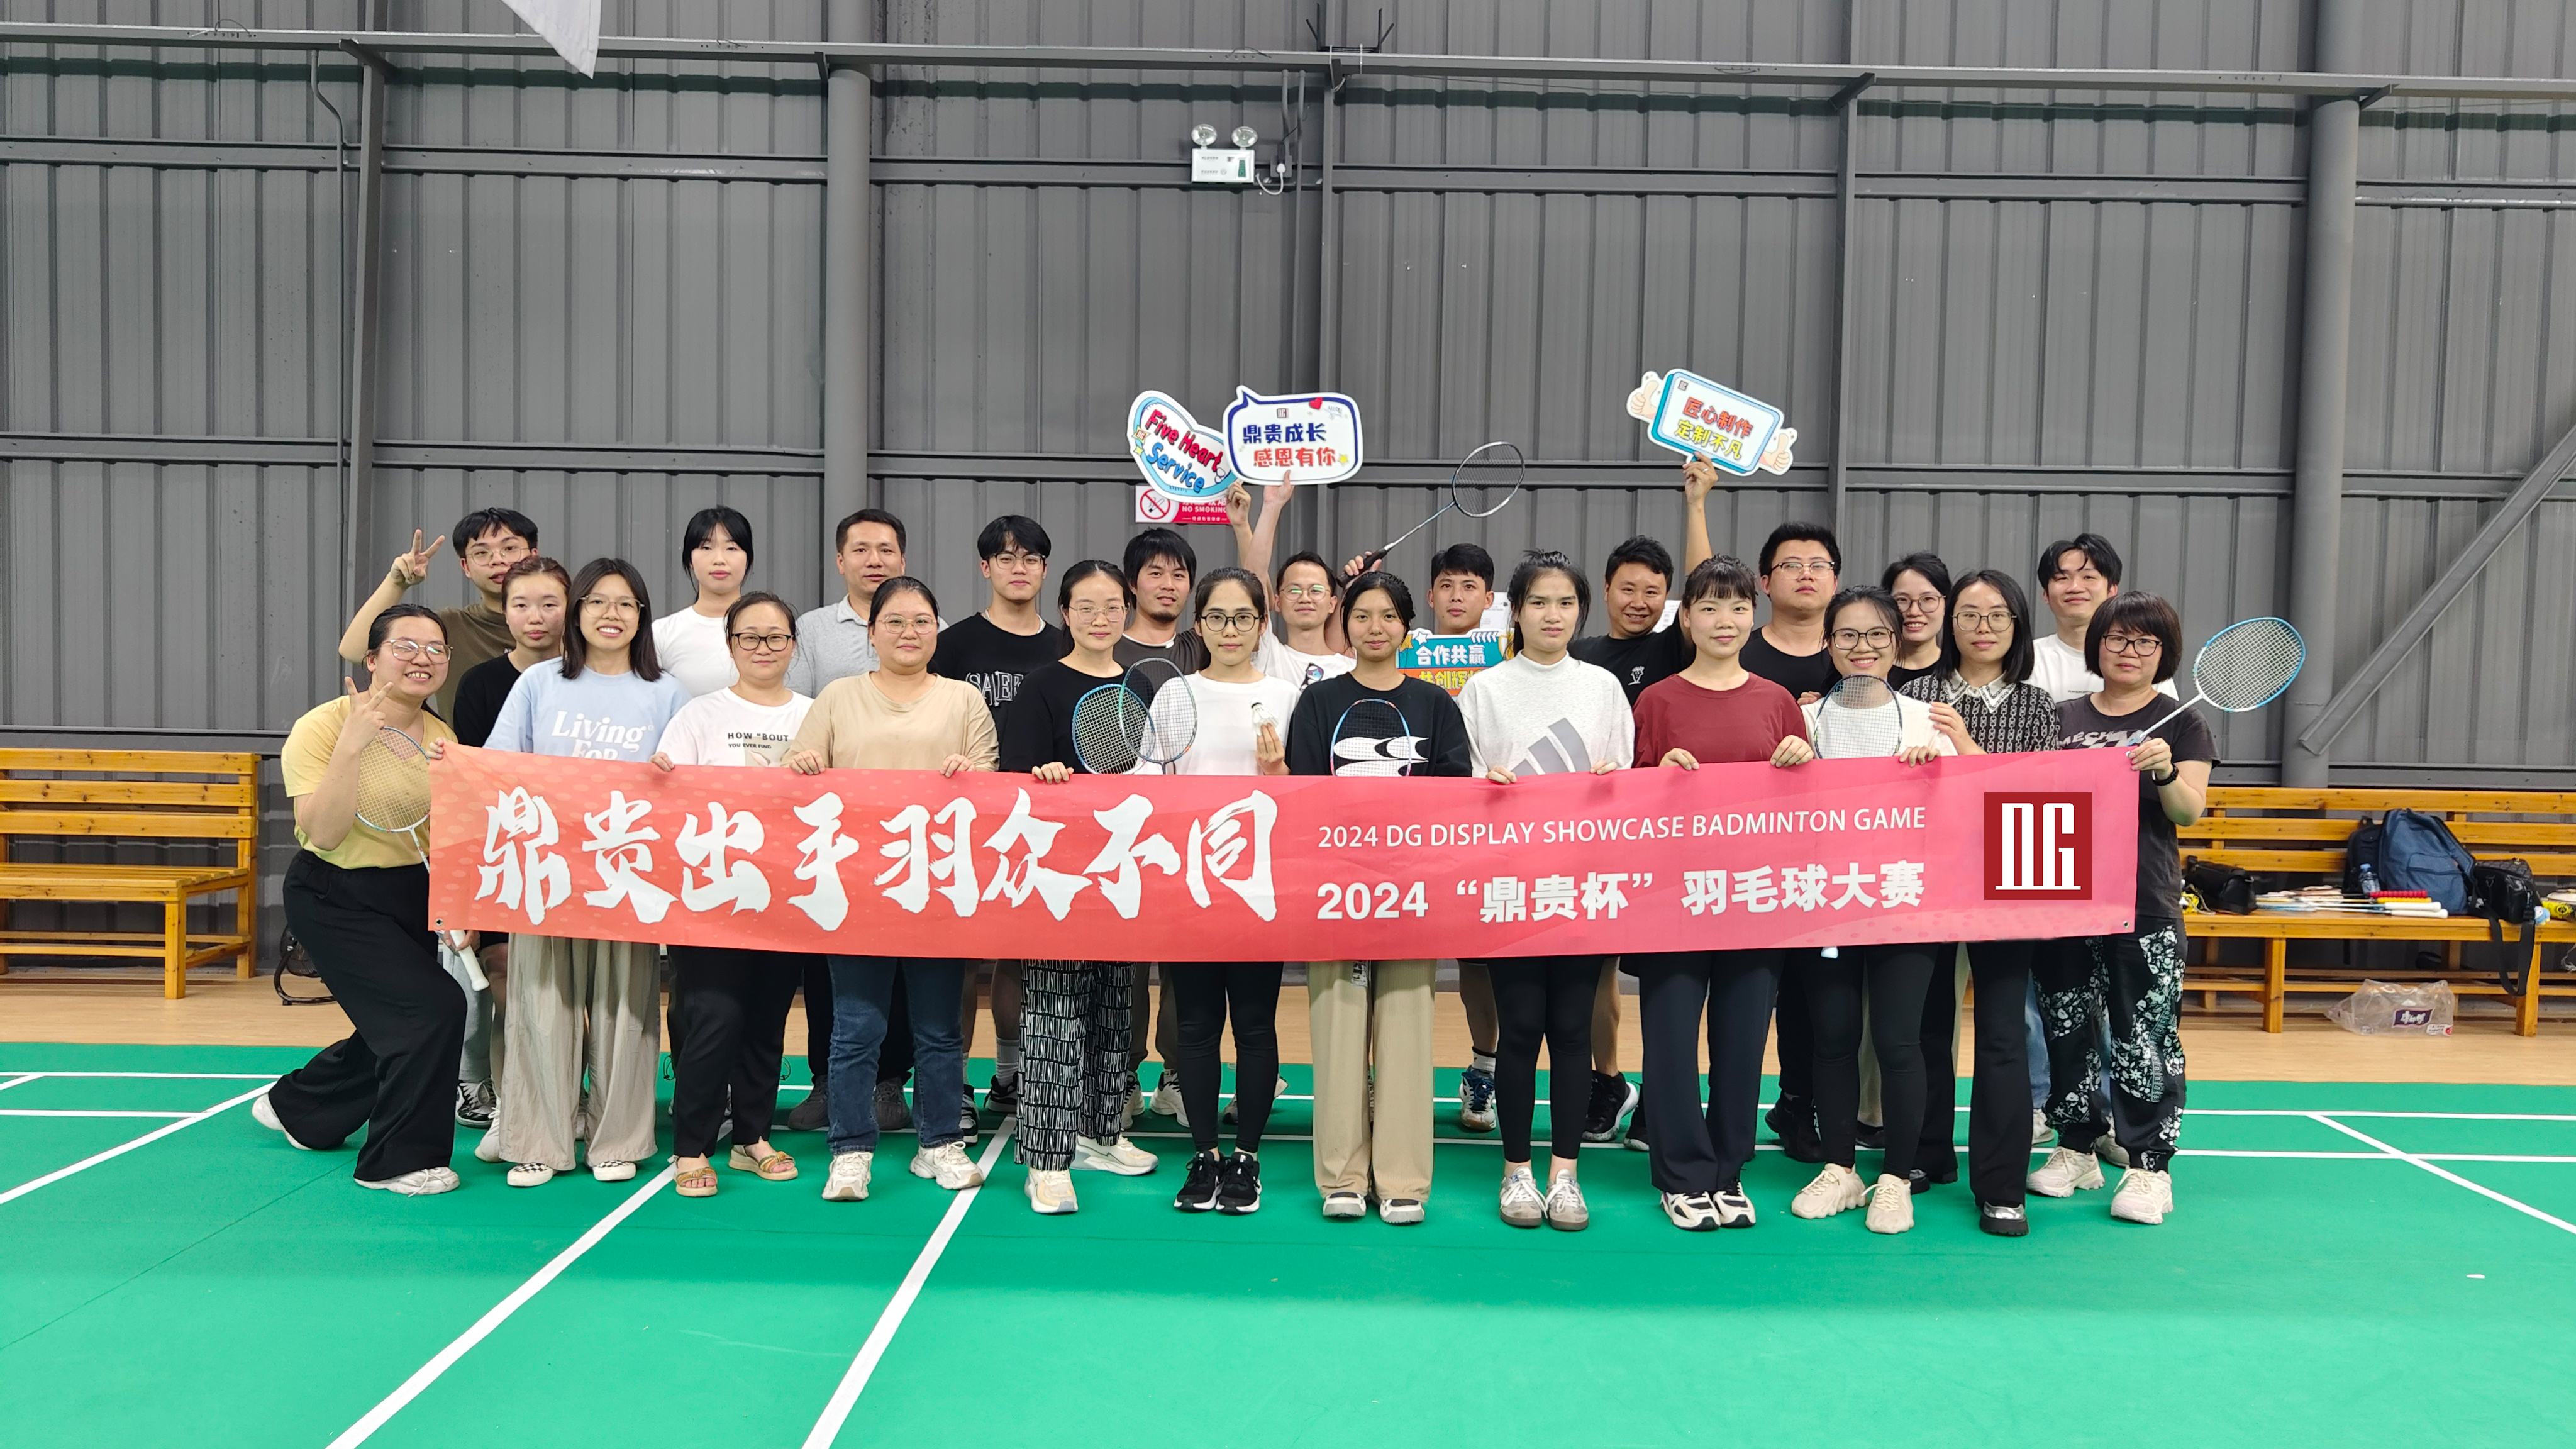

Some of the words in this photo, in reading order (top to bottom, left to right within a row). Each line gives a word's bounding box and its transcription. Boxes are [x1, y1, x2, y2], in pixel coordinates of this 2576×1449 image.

[1243, 423, 1327, 444] 鼎贵成长
[1683, 397, 1753, 438] 匠心制作
[1145, 409, 1179, 445] Five
[1178, 430, 1223, 472] Heart
[1253, 447, 1336, 467] 感恩有你
[1674, 419, 1742, 460] 定制不凡
[1146, 442, 1205, 493] Service
[1415, 644, 1486, 666] 合作共赢
[1318, 825, 1379, 848] 2024
[1387, 824, 1422, 847] DG
[1431, 821, 1536, 846] DISPLAY
[1543, 816, 1684, 842] SHOWCASE
[1692, 809, 1846, 836] BADMINTON
[1853, 806, 1926, 831] GAME
[1995, 802, 2081, 891] DG
[475, 786, 1279, 931] 鼎贵出手羽众不同
[1317, 881, 1429, 919] 2024
[1680, 860, 1925, 916] 羽毛球大赛
